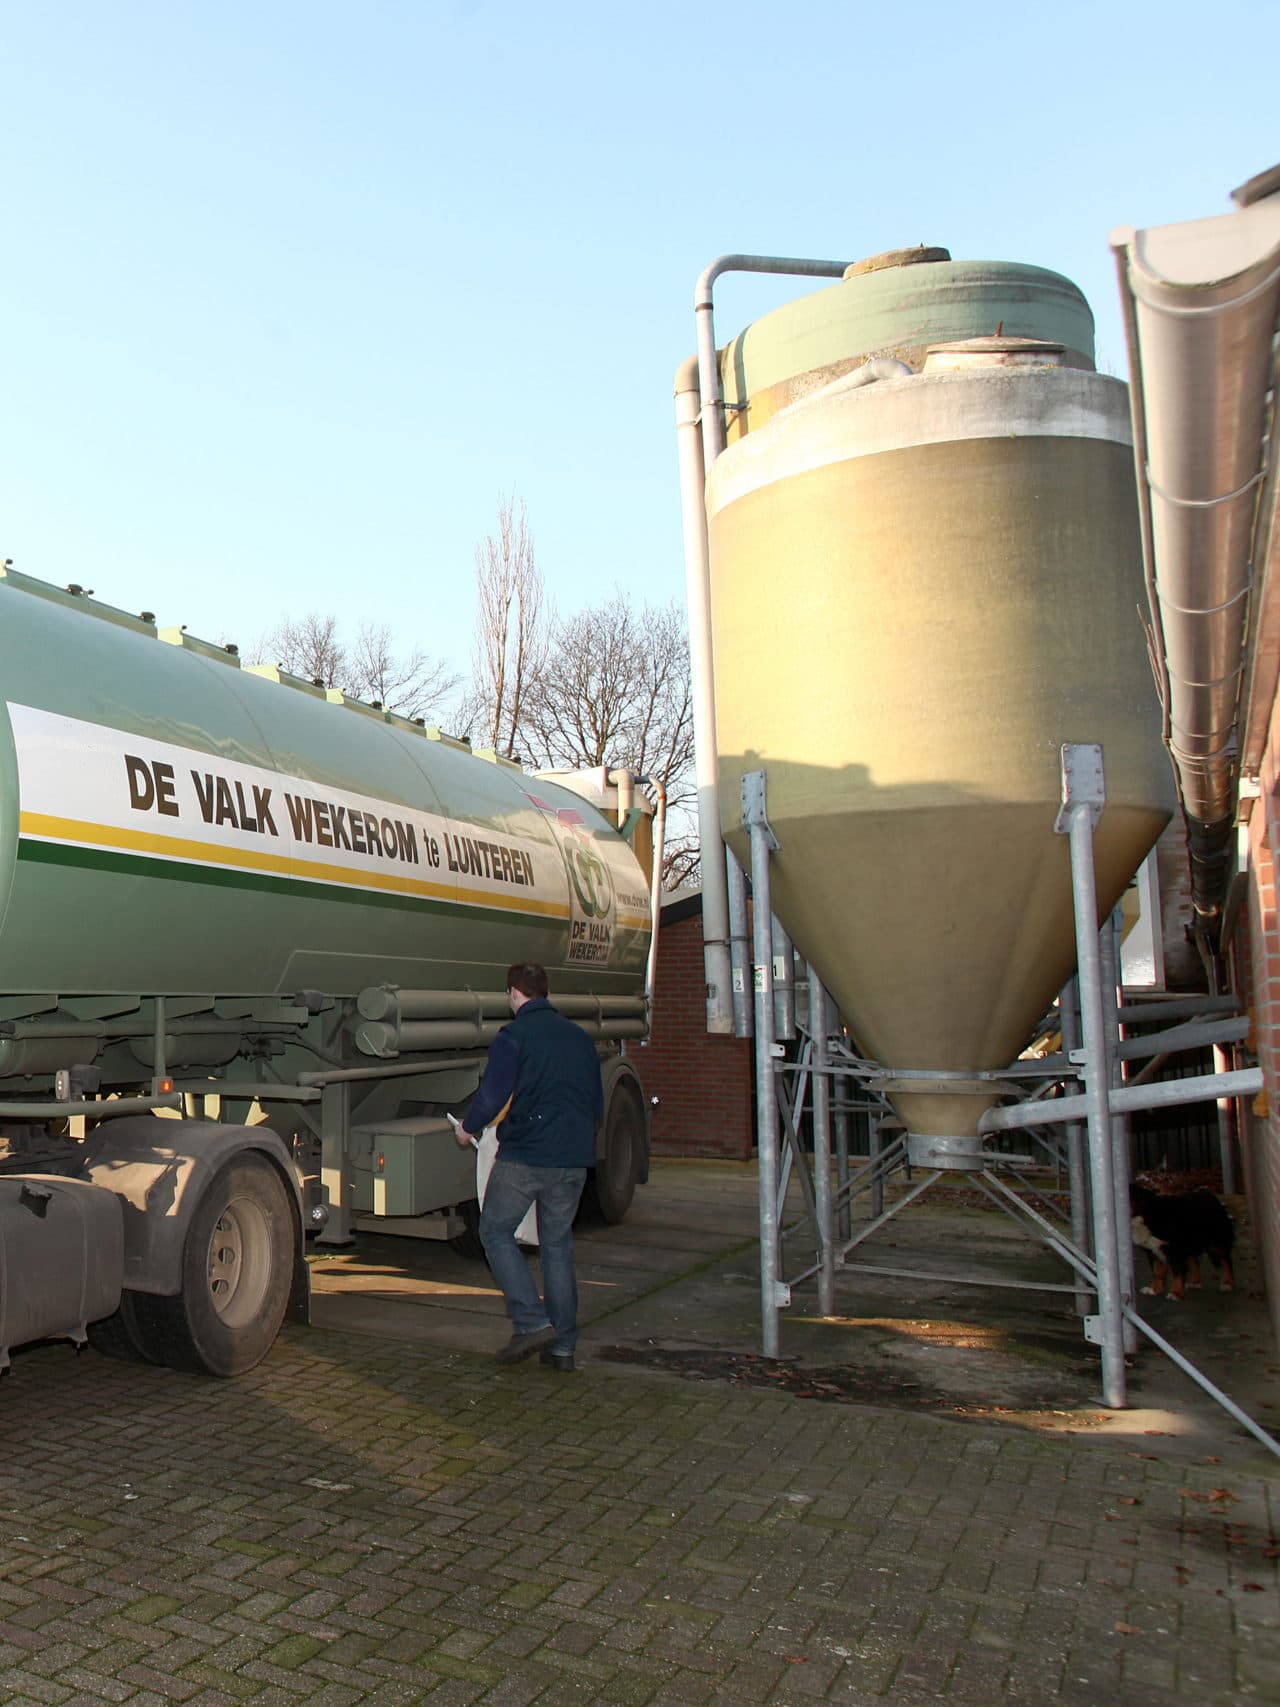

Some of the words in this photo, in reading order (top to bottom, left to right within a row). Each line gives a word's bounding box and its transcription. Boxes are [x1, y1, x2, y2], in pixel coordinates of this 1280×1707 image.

[124, 754, 180, 818] DE
[190, 769, 279, 837] VALK
[284, 793, 420, 865] WEKEROM
[423, 828, 440, 869] te
[444, 832, 535, 887] LUNTEREN
[572, 920, 586, 940] DE
[588, 923, 611, 944] VALK
